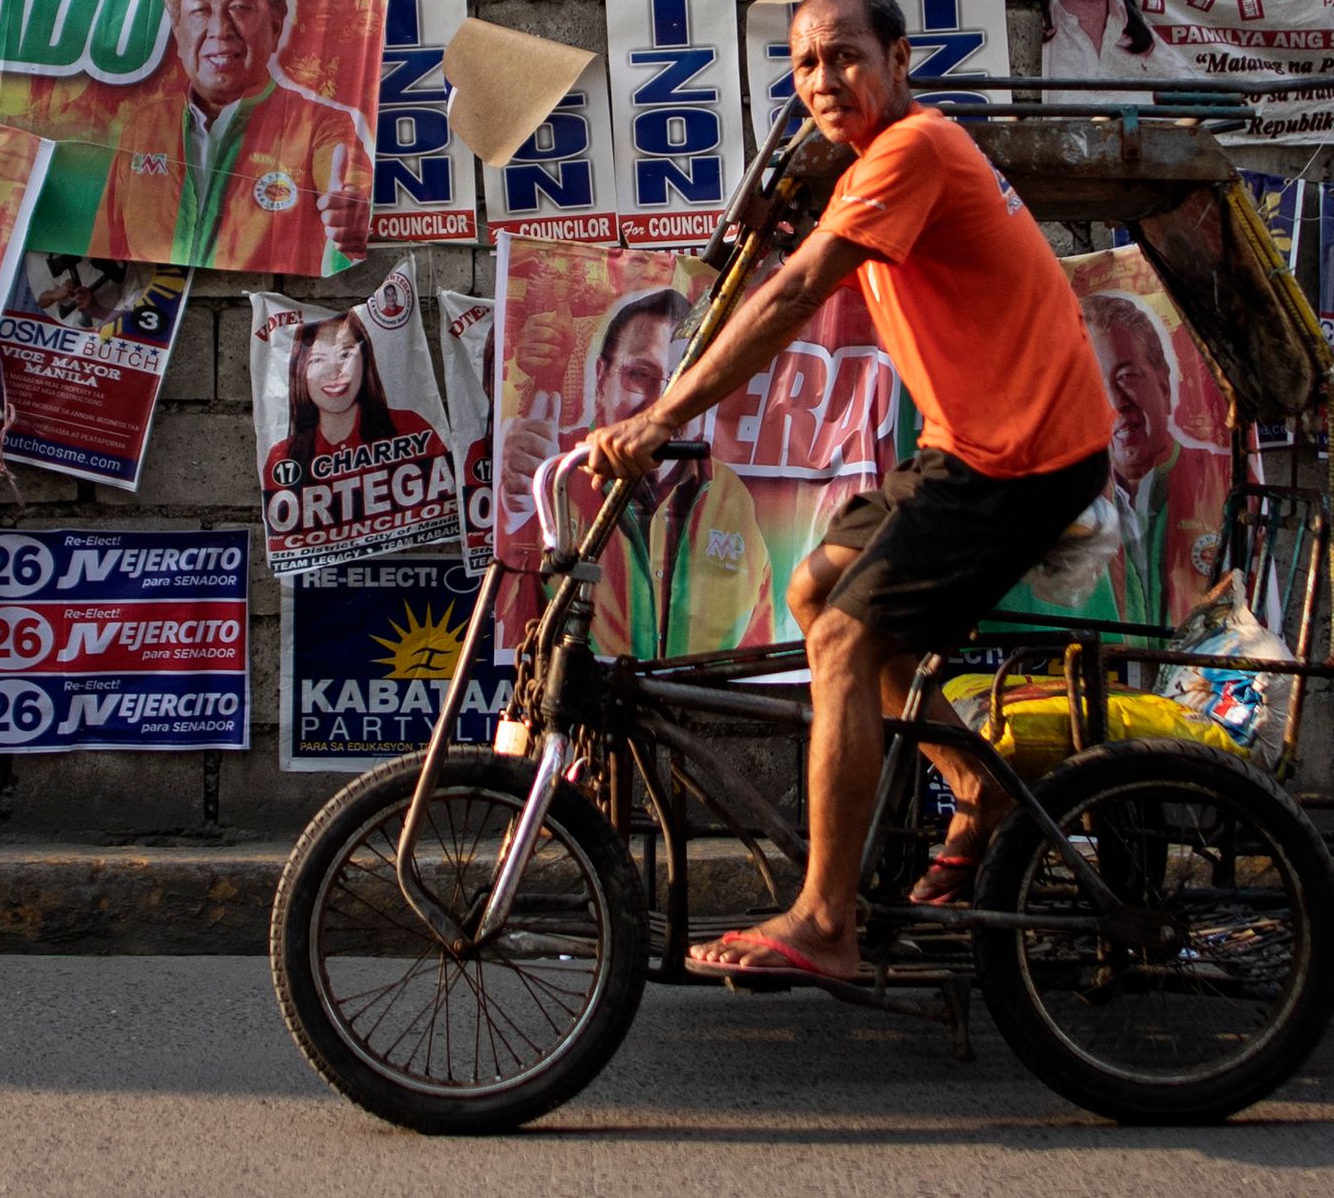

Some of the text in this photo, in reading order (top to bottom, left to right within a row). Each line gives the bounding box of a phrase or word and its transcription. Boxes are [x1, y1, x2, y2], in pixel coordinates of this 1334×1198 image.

[1172, 28, 1264, 47] PAMILYA
[1273, 31, 1322, 49] ANG
[1287, 59, 1312, 73] na
[378, 214, 468, 240] COUNCILOR
[620, 220, 646, 241] For
[139, 311, 159, 330] 3
[2, 345, 121, 380] VICE MAYOR
[82, 341, 159, 372] BUTCH
[24, 362, 98, 387] MANILA
[311, 429, 433, 480] CHARRY
[273, 463, 296, 484] 17
[268, 455, 457, 533] ORTEGA
[64, 535, 122, 548] Re-Elect!
[271, 527, 412, 561] 5th District, City of
[273, 537, 415, 571] TEAM LEGACY TEAM
[142, 574, 236, 588] para SENADOR
[64, 607, 122, 620] Re-Elect!
[142, 647, 236, 661] para SENADOR
[64, 679, 122, 693] Re-Elect!
[142, 720, 236, 734] para SENADOR
